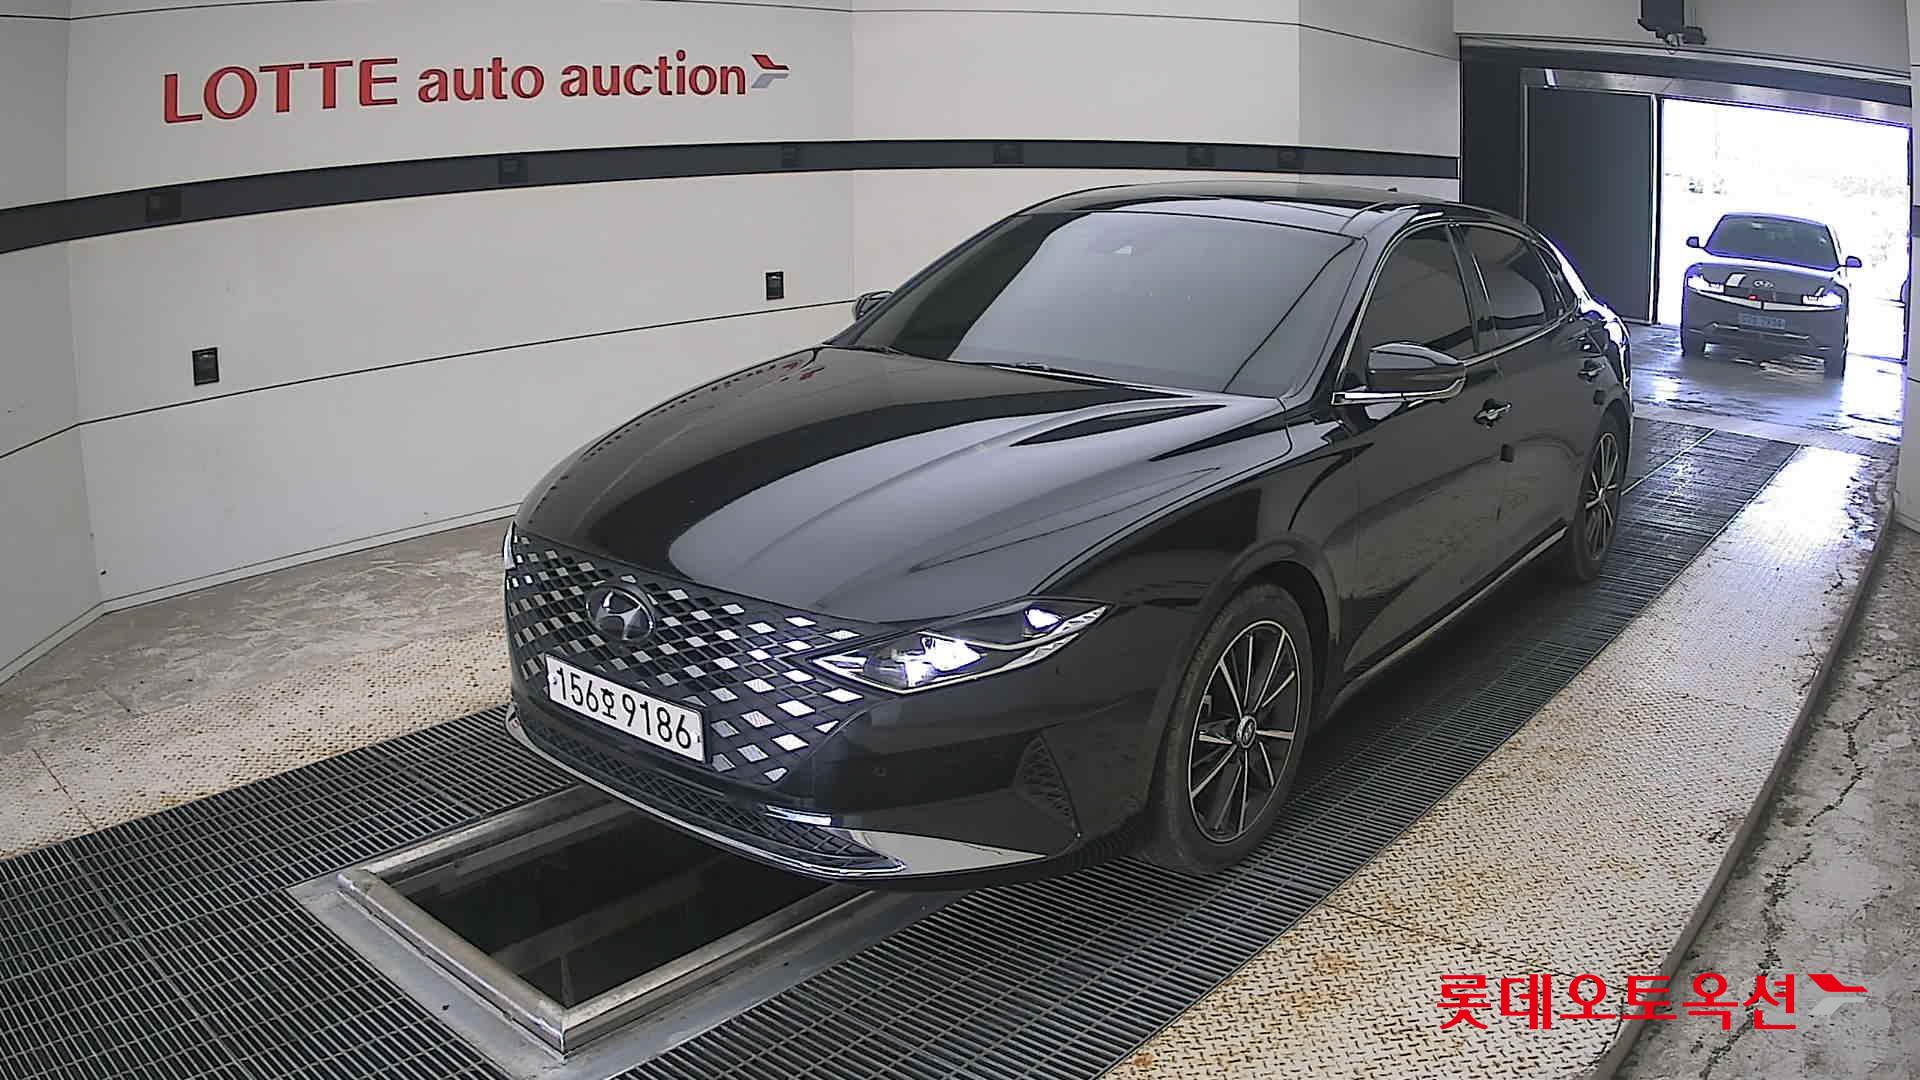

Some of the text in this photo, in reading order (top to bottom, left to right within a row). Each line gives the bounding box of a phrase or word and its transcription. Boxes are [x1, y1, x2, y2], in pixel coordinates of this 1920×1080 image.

[163, 50, 747, 124] LOTTE auto auction
